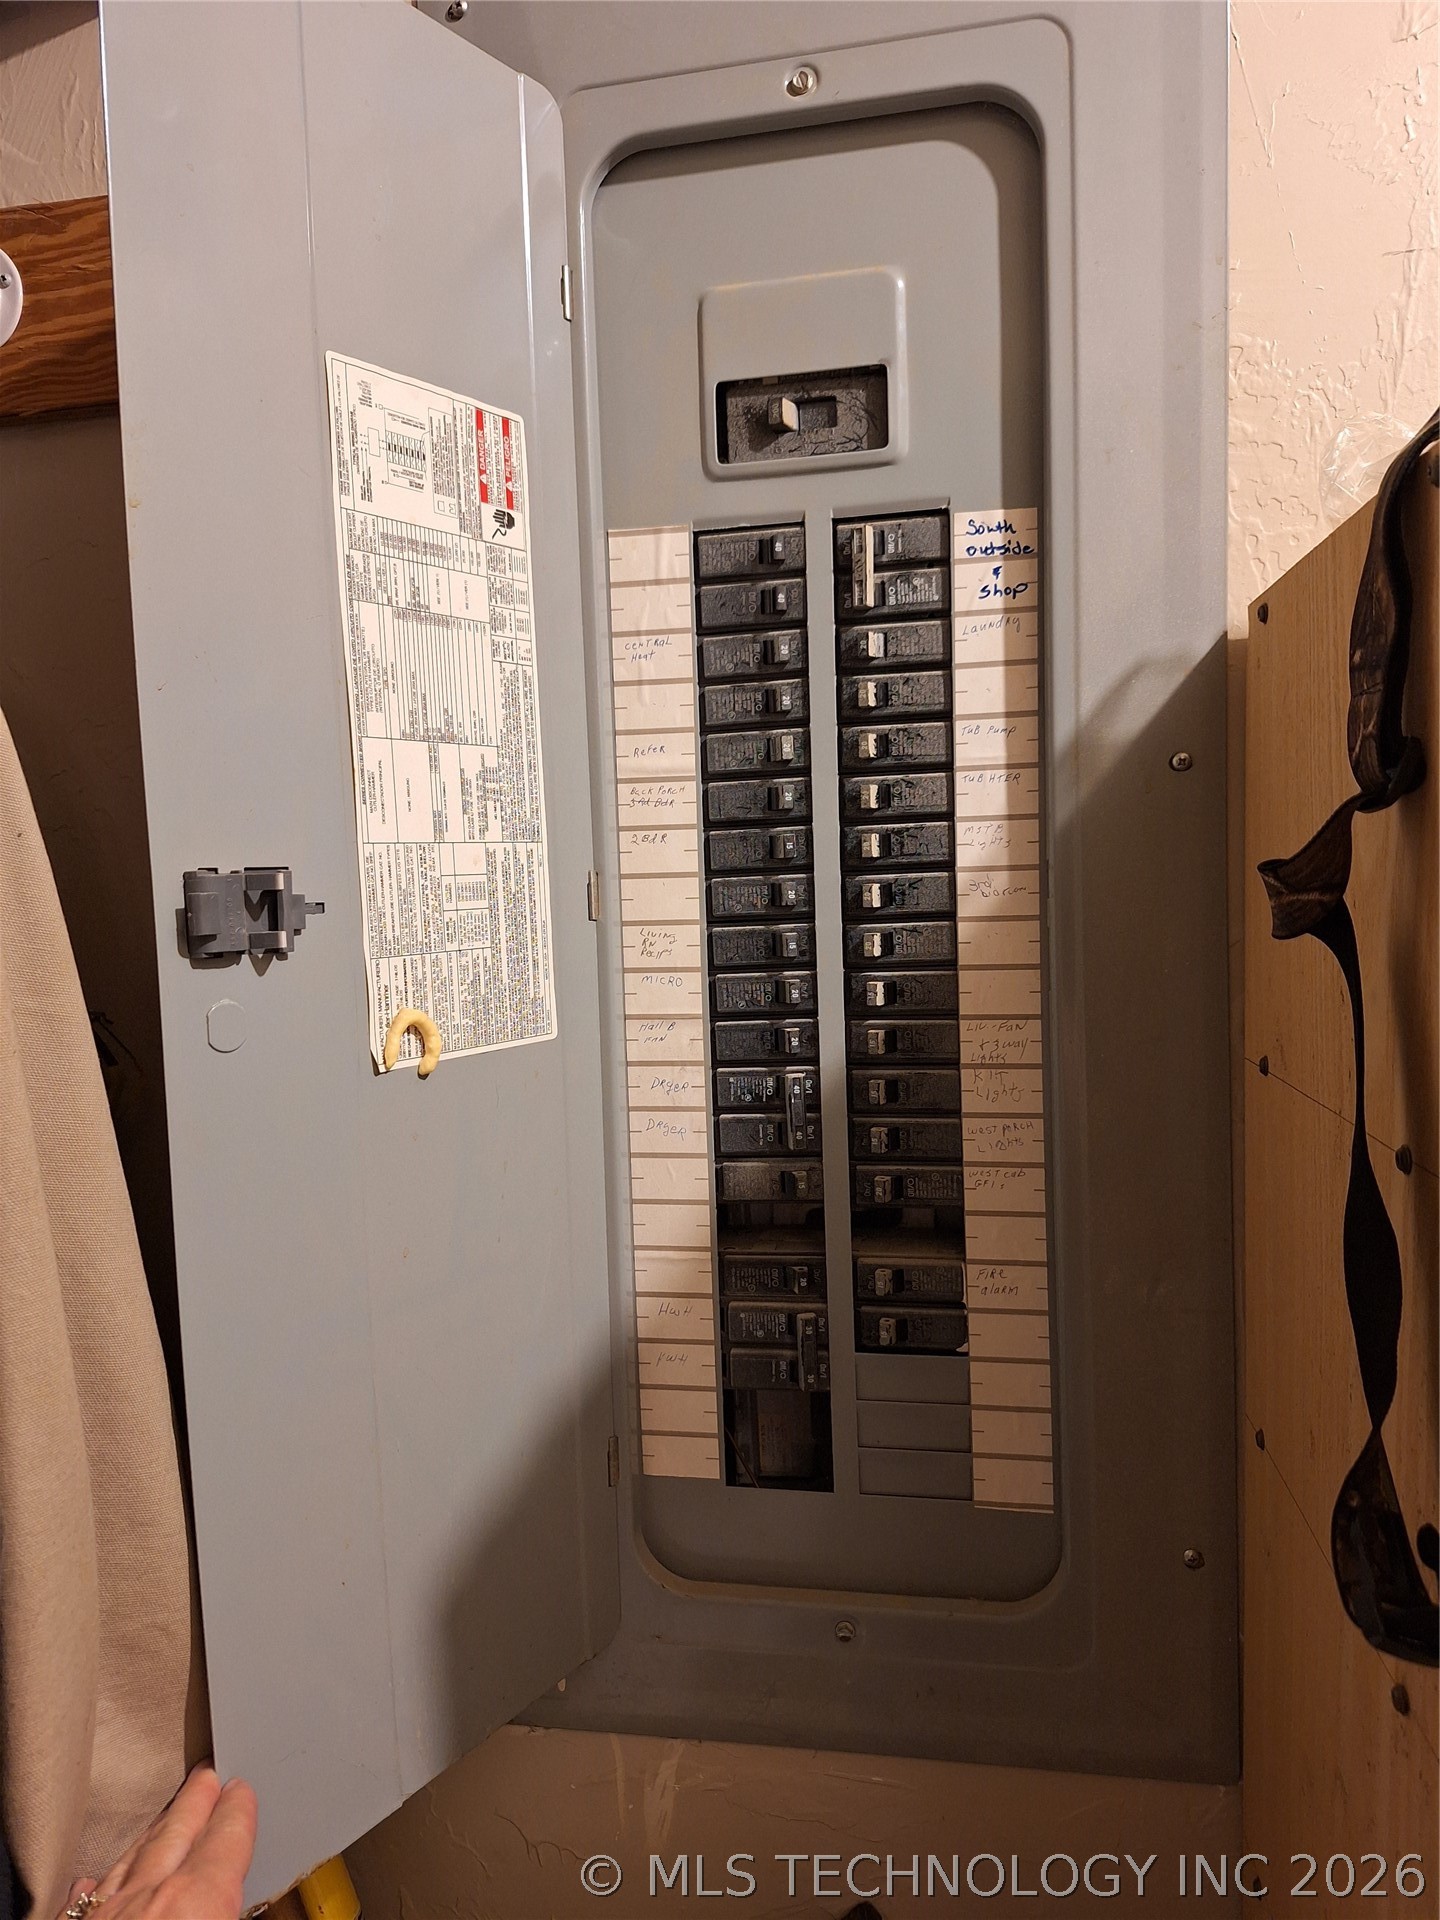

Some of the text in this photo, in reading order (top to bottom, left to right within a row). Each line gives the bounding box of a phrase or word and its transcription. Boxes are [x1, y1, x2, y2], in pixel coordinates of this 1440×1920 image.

[477, 429, 486, 471] DANGER
[503, 435, 511, 478] PELIGRO
[966, 519, 1016, 535] South
[775, 542, 782, 552] 40
[778, 593, 785, 603] 40
[781, 644, 789, 655] 20
[783, 695, 790, 705] 20
[783, 743, 791, 752] 20
[785, 792, 792, 801] 20
[788, 890, 795, 899] 20
[791, 989, 799, 998] 20
[791, 1037, 799, 1046] 20
[793, 1085, 800, 1094] 40
[796, 1131, 803, 1140] 40
[801, 1277, 807, 1287] 20
[808, 1374, 814, 1383] 30
